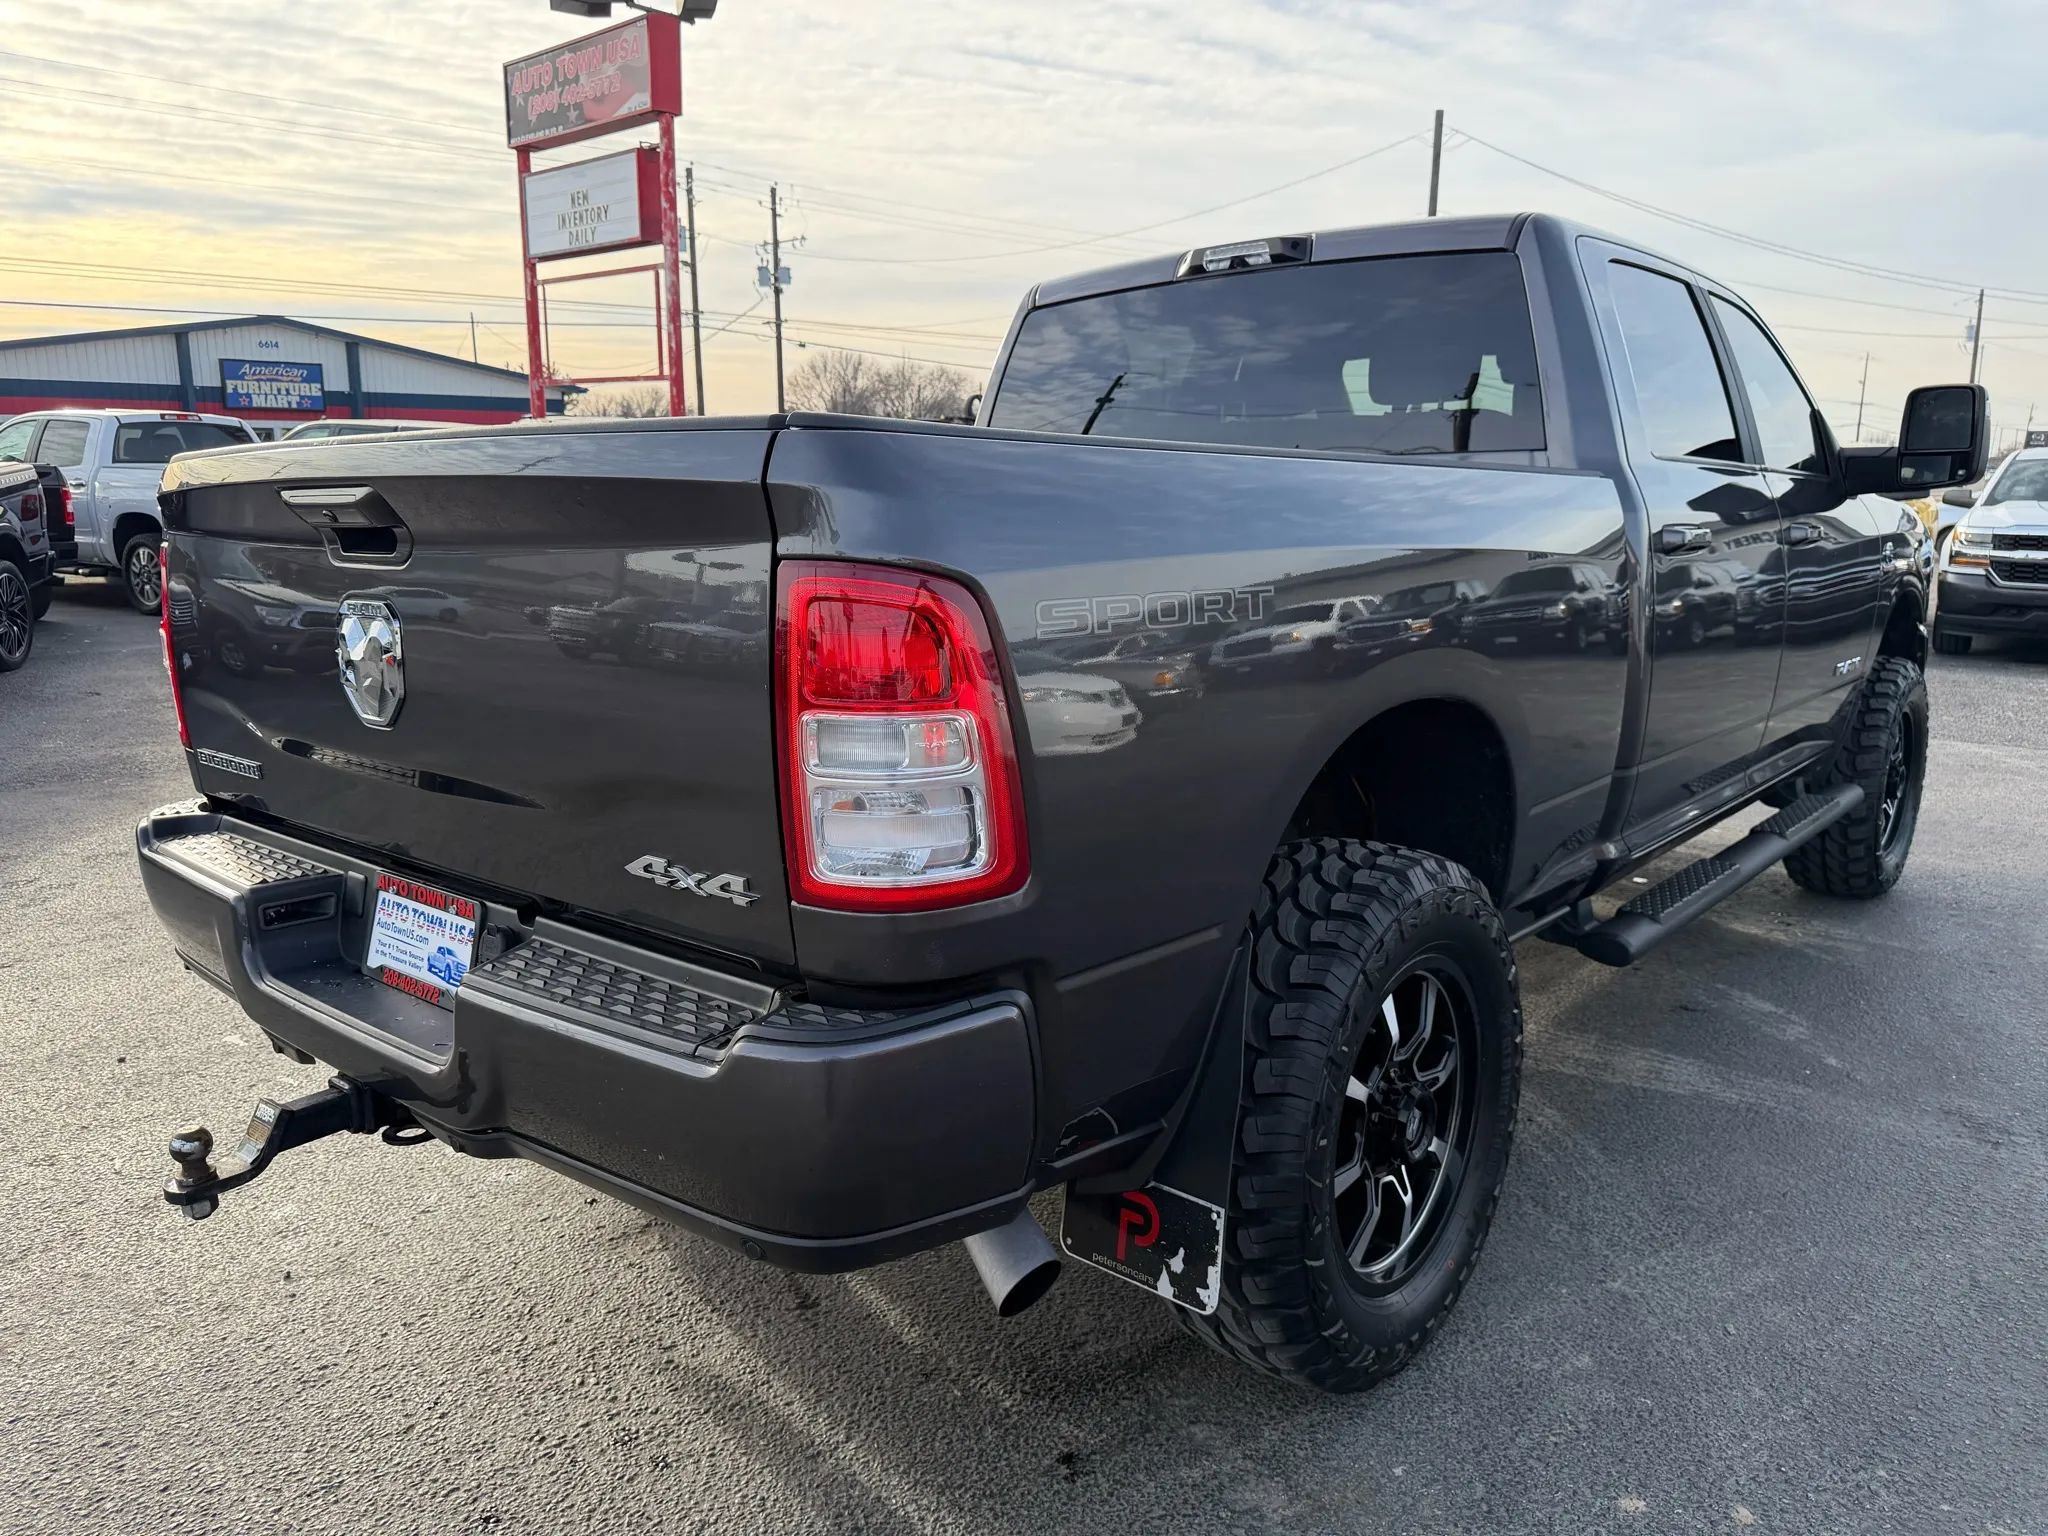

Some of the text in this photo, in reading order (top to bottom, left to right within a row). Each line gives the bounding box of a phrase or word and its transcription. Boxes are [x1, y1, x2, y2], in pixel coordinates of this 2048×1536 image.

[511, 34, 641, 95] AUTO TOWN USA
[557, 205, 609, 231] INVENTORY
[568, 226, 597, 246] DAILY
[258, 340, 279, 349] 6614
[238, 363, 308, 378] American
[226, 380, 322, 396] FURNITURE
[252, 395, 300, 408] MART
[347, 603, 382, 616] RAM
[1035, 585, 1275, 640] SPORT
[197, 749, 260, 778] BIGHORN
[377, 874, 409, 897] AUTO
[411, 884, 447, 910] TOWN
[376, 896, 410, 924] AUTO
[410, 907, 448, 938] TOWN
[375, 918, 430, 946] AutoTownUS.com
